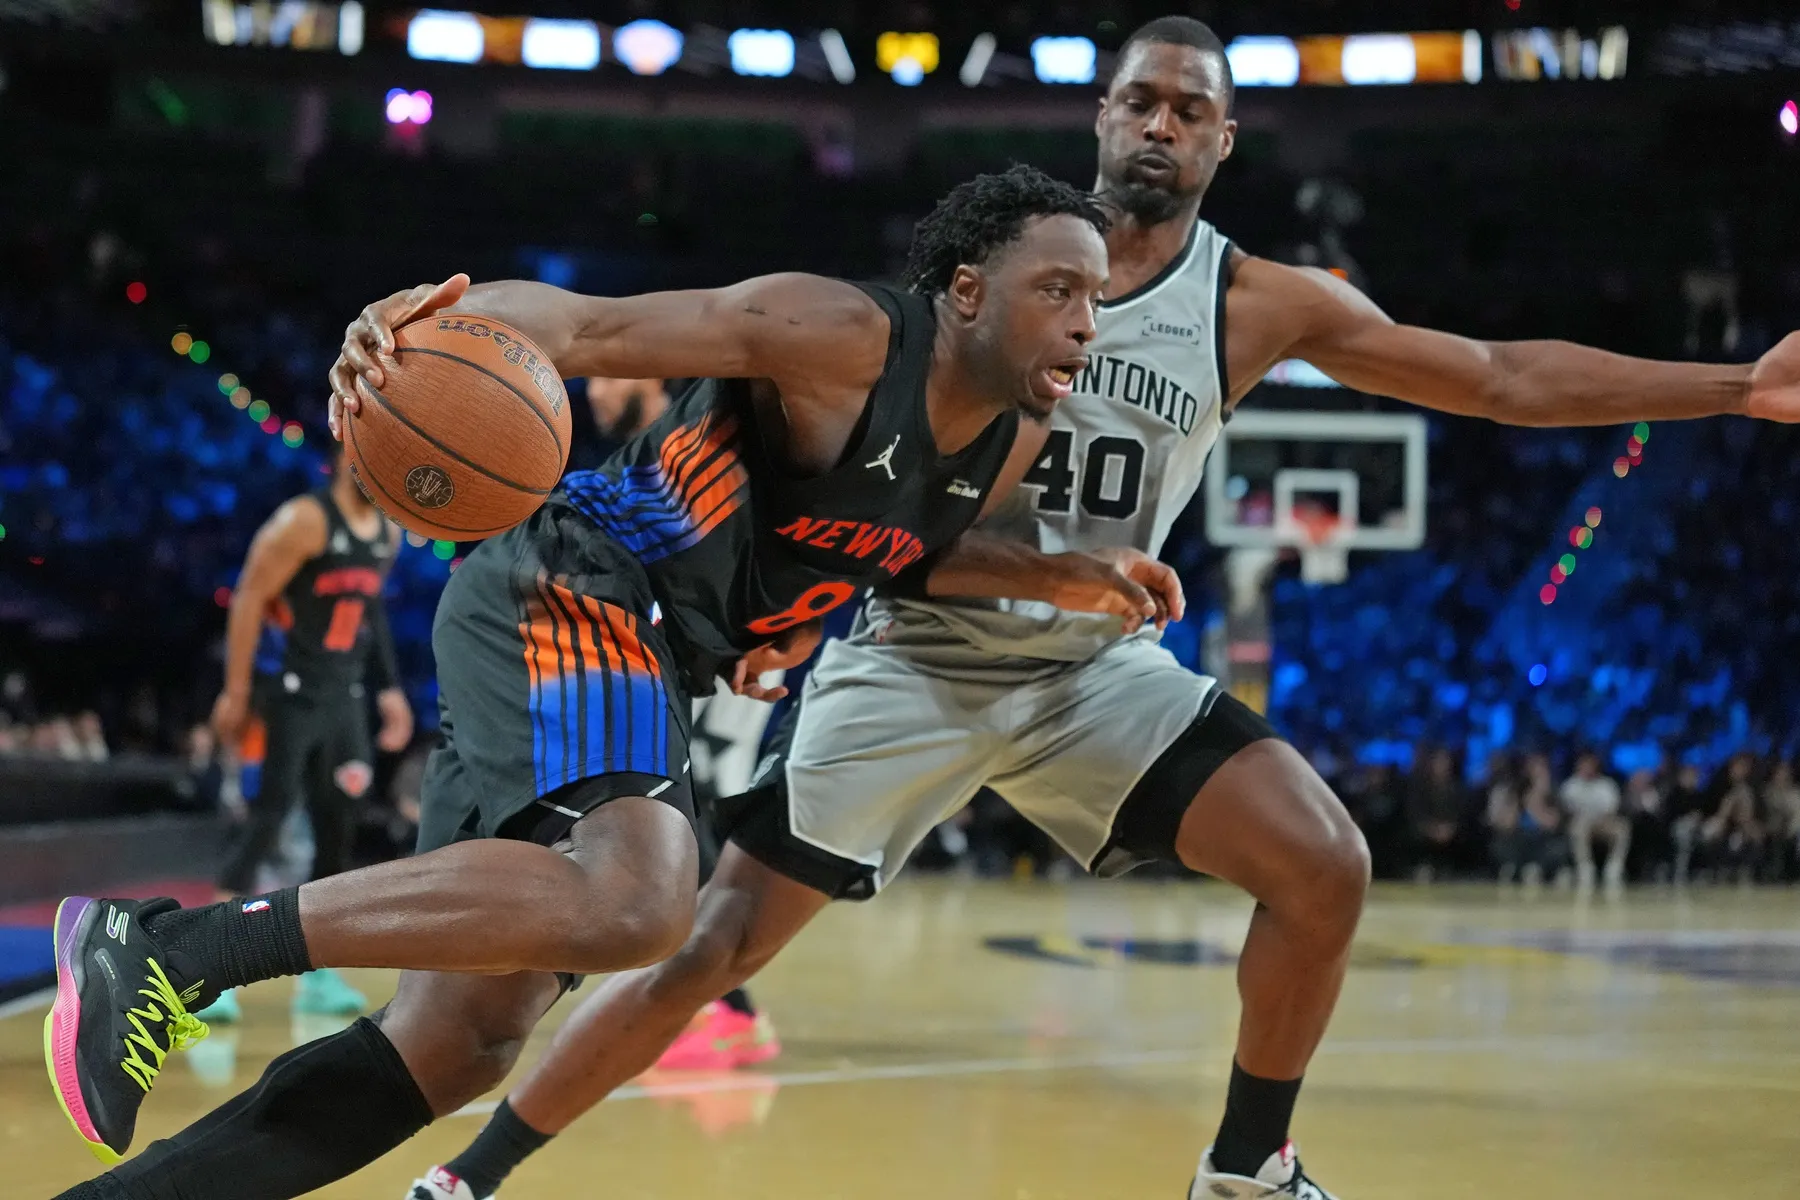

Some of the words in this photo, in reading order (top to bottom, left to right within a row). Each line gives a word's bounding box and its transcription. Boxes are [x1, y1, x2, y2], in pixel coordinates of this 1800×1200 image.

[1150, 322, 1193, 338] LEDGER
[1021, 429, 1146, 520] 40
[775, 517, 892, 558] NEW
[746, 582, 856, 636] 8
